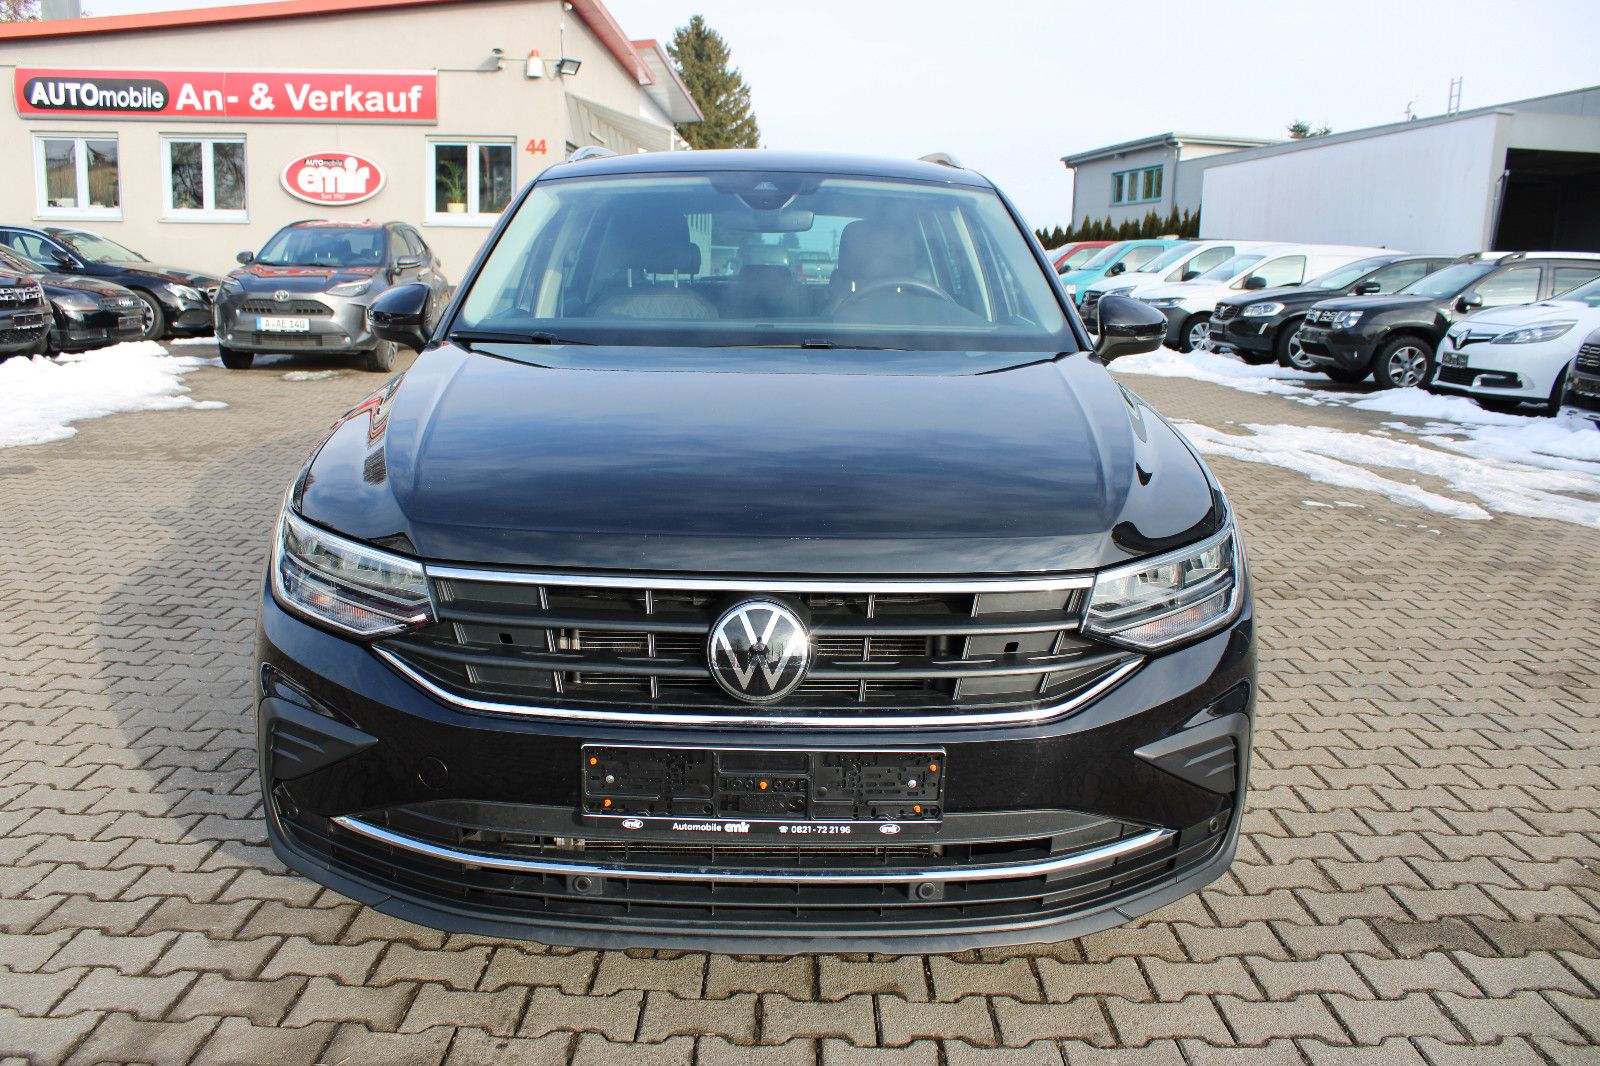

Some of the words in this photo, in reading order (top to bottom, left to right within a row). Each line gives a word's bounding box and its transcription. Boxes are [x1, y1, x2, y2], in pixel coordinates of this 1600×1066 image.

[30, 82, 164, 109] AUTOmobile
[175, 83, 239, 111] An-
[249, 82, 276, 111] &
[284, 83, 424, 113] Verkauf
[525, 139, 547, 155] 44
[297, 156, 370, 194] emir
[672, 822, 722, 833] Automobile
[723, 821, 750, 833] emir
